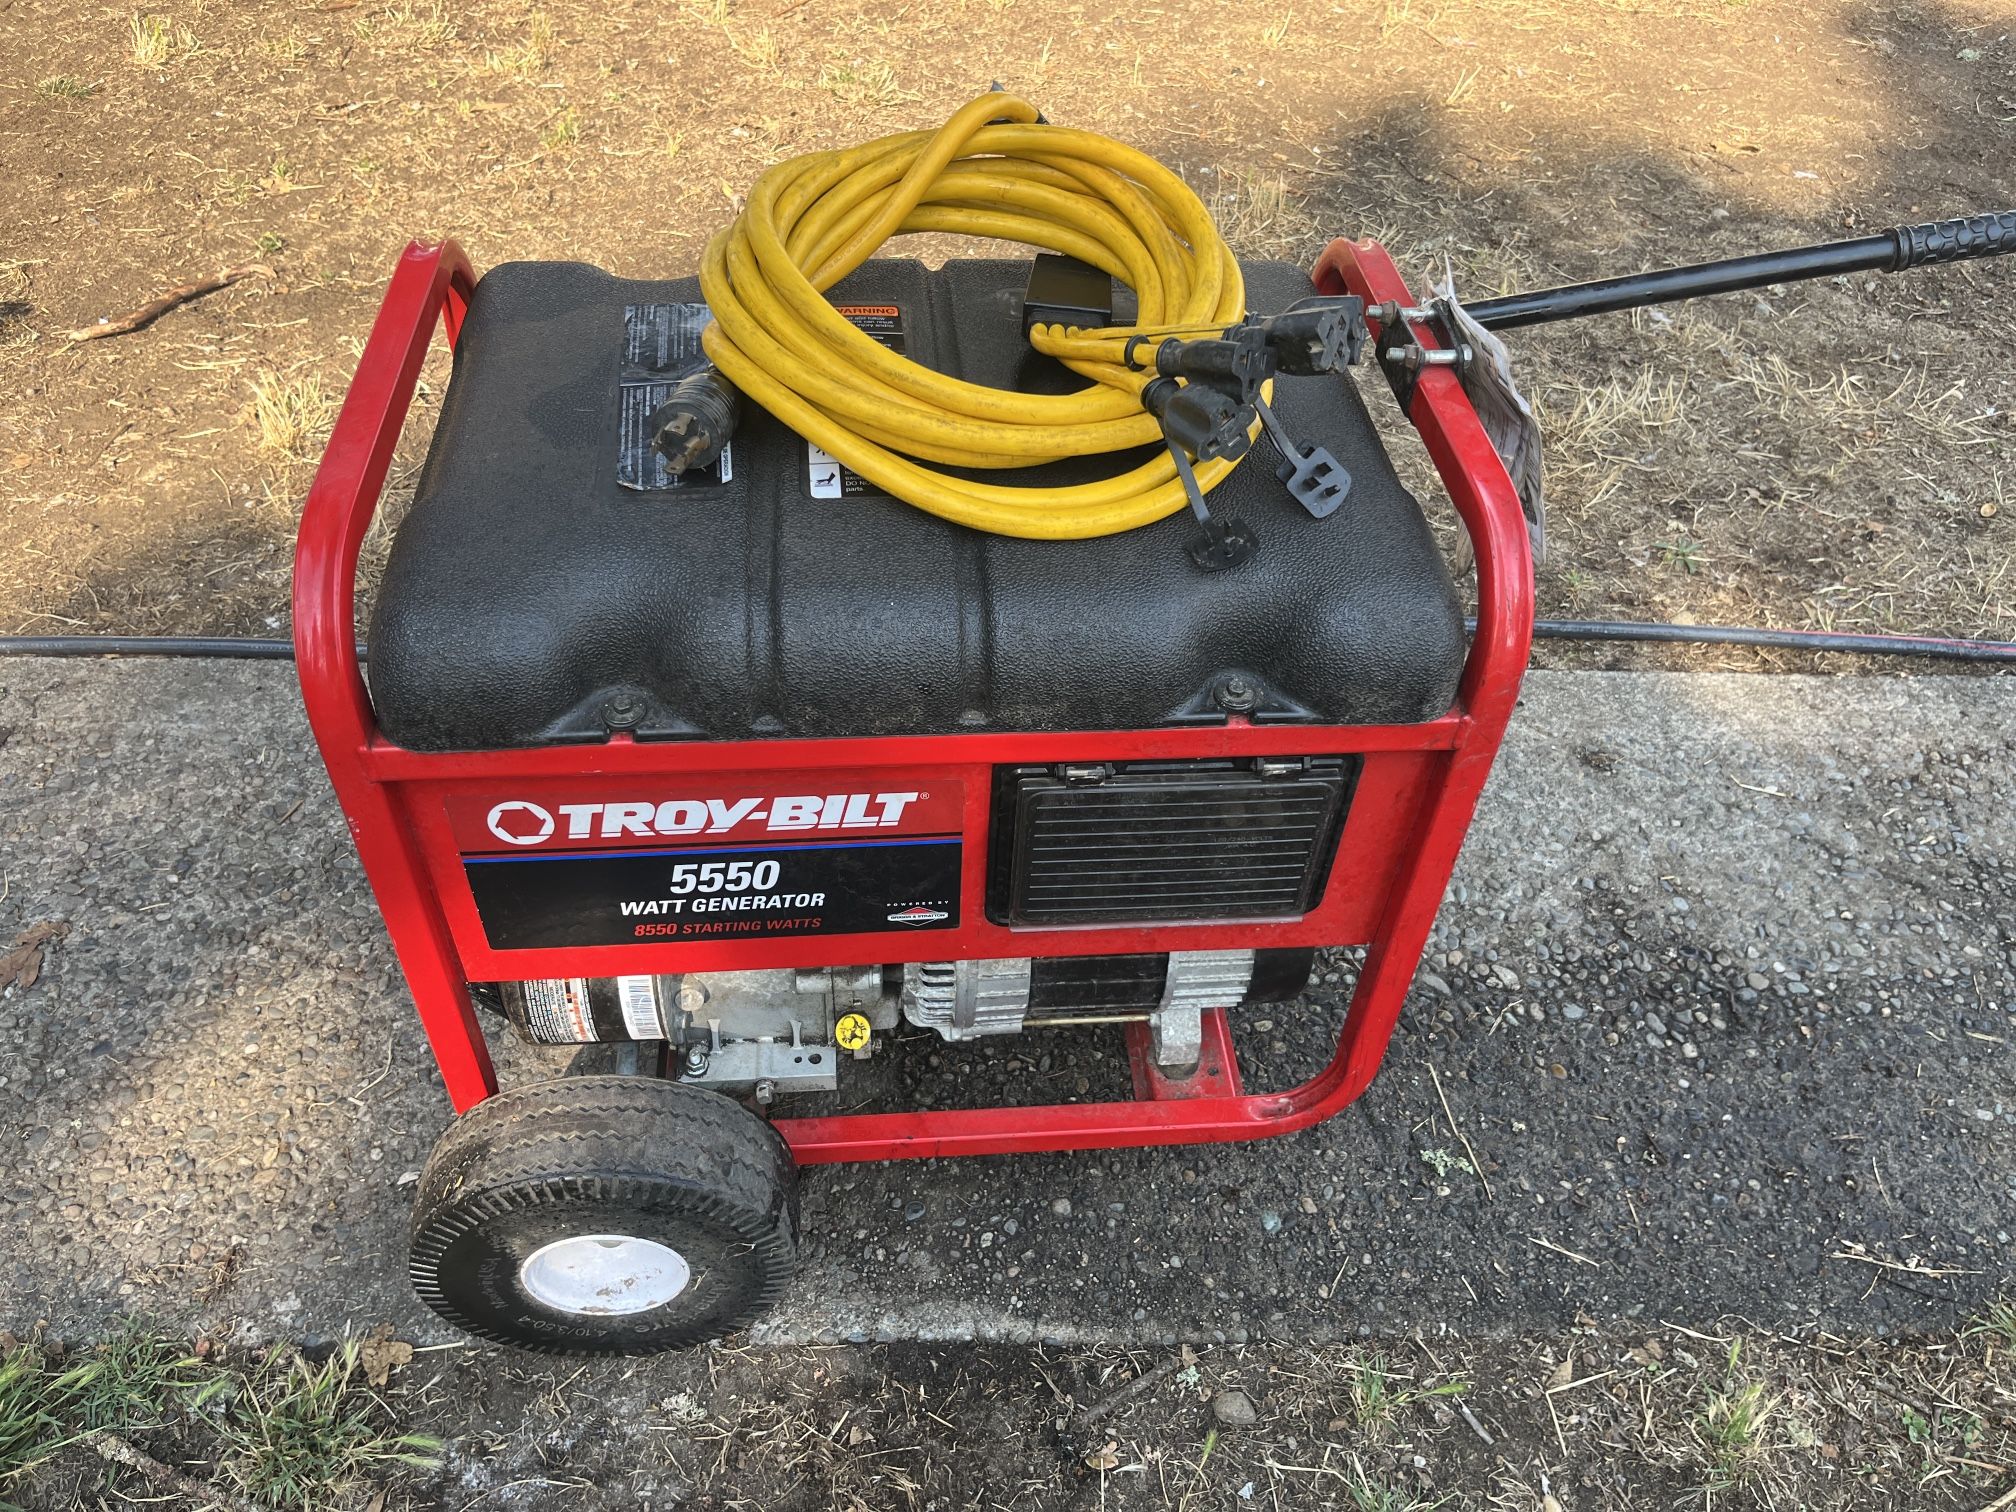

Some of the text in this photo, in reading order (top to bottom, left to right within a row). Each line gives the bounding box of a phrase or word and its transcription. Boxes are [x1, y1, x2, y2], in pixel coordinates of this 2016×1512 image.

[558, 791, 918, 839] TROY-BILT
[670, 860, 781, 894] 5550
[620, 892, 826, 916] WATT GENERATOR
[634, 917, 822, 937] 8550 STARTING WATTS
